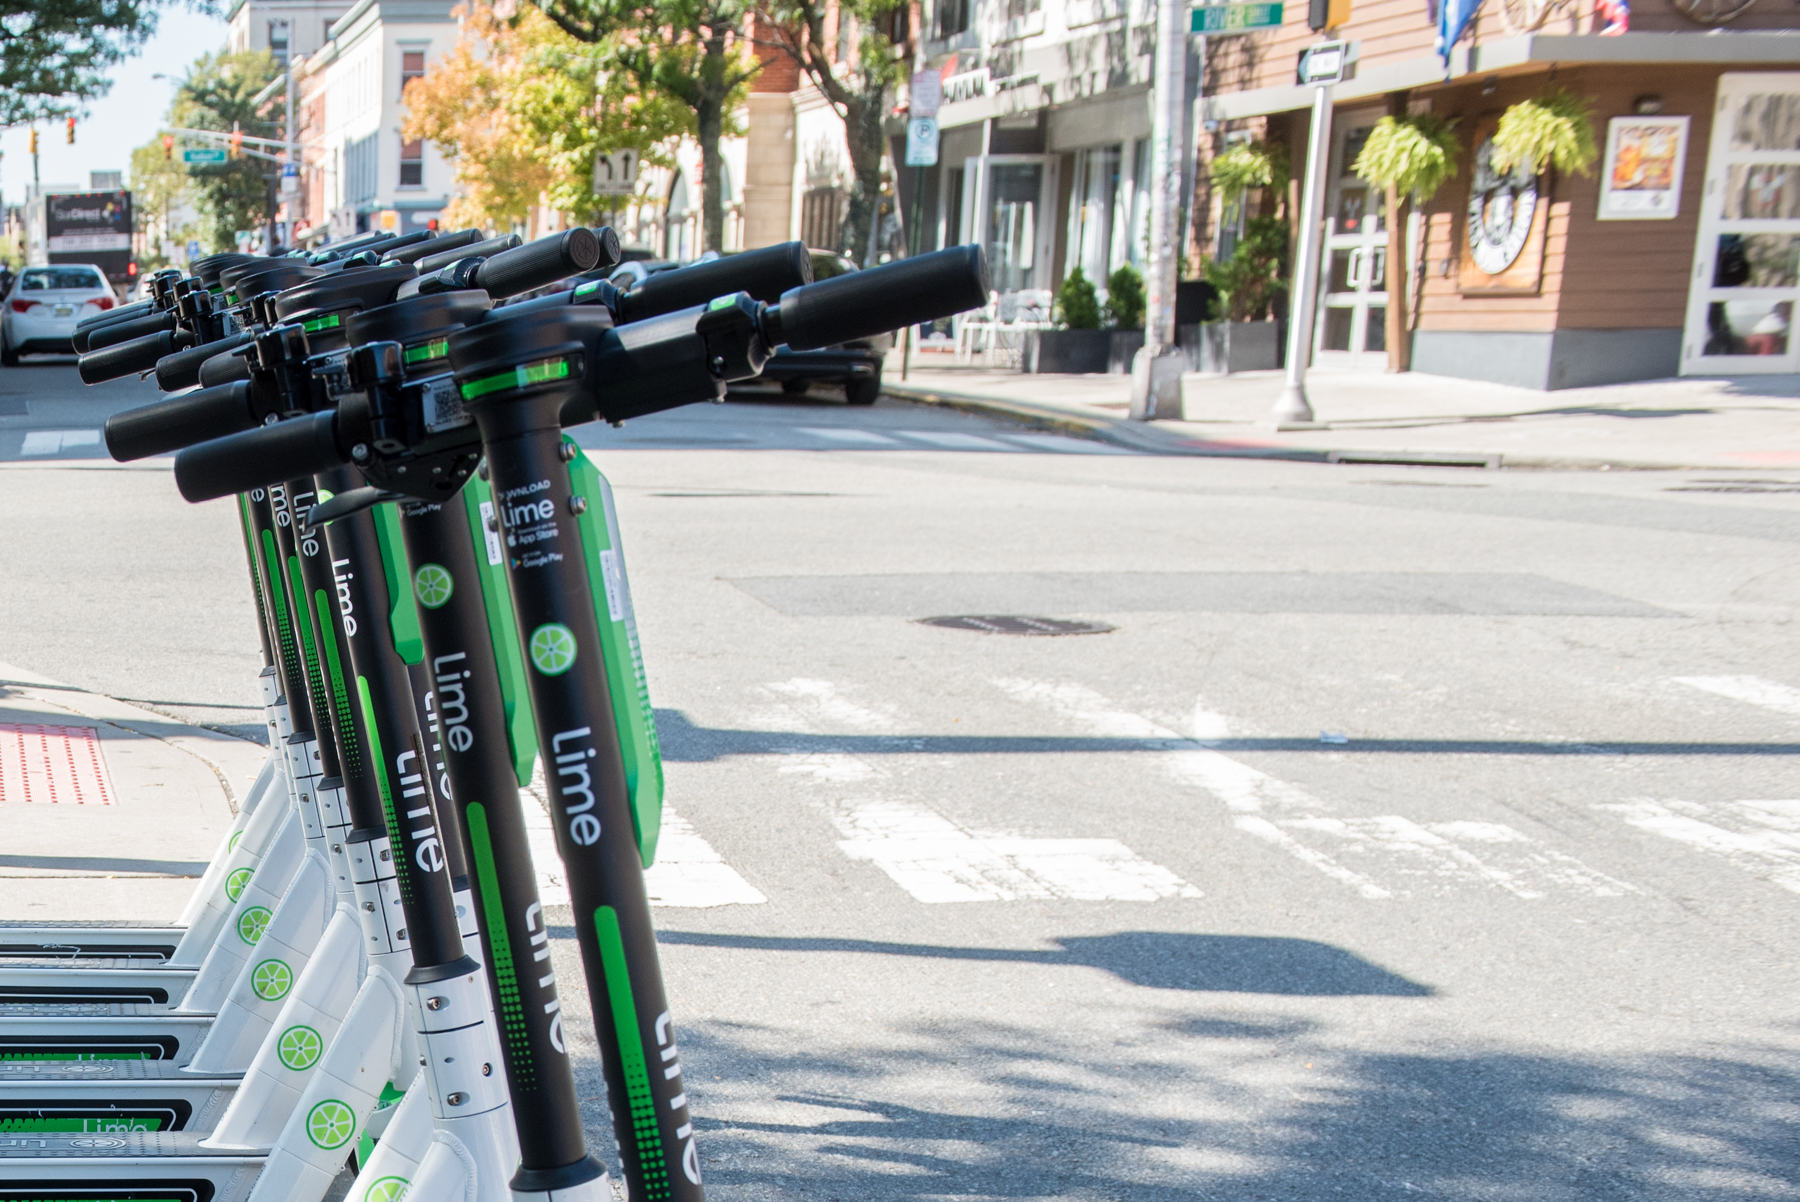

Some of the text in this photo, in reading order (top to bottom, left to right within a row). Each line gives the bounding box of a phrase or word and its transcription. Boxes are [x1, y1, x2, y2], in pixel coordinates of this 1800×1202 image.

[407, 502, 442, 517] Google Play
[501, 499, 555, 528] Lime
[519, 528, 559, 545] App Store
[522, 556, 548, 568] Google
[548, 552, 564, 563] Play
[331, 558, 357, 637] Lime
[433, 651, 474, 754] Lime
[552, 726, 602, 847] Lime
